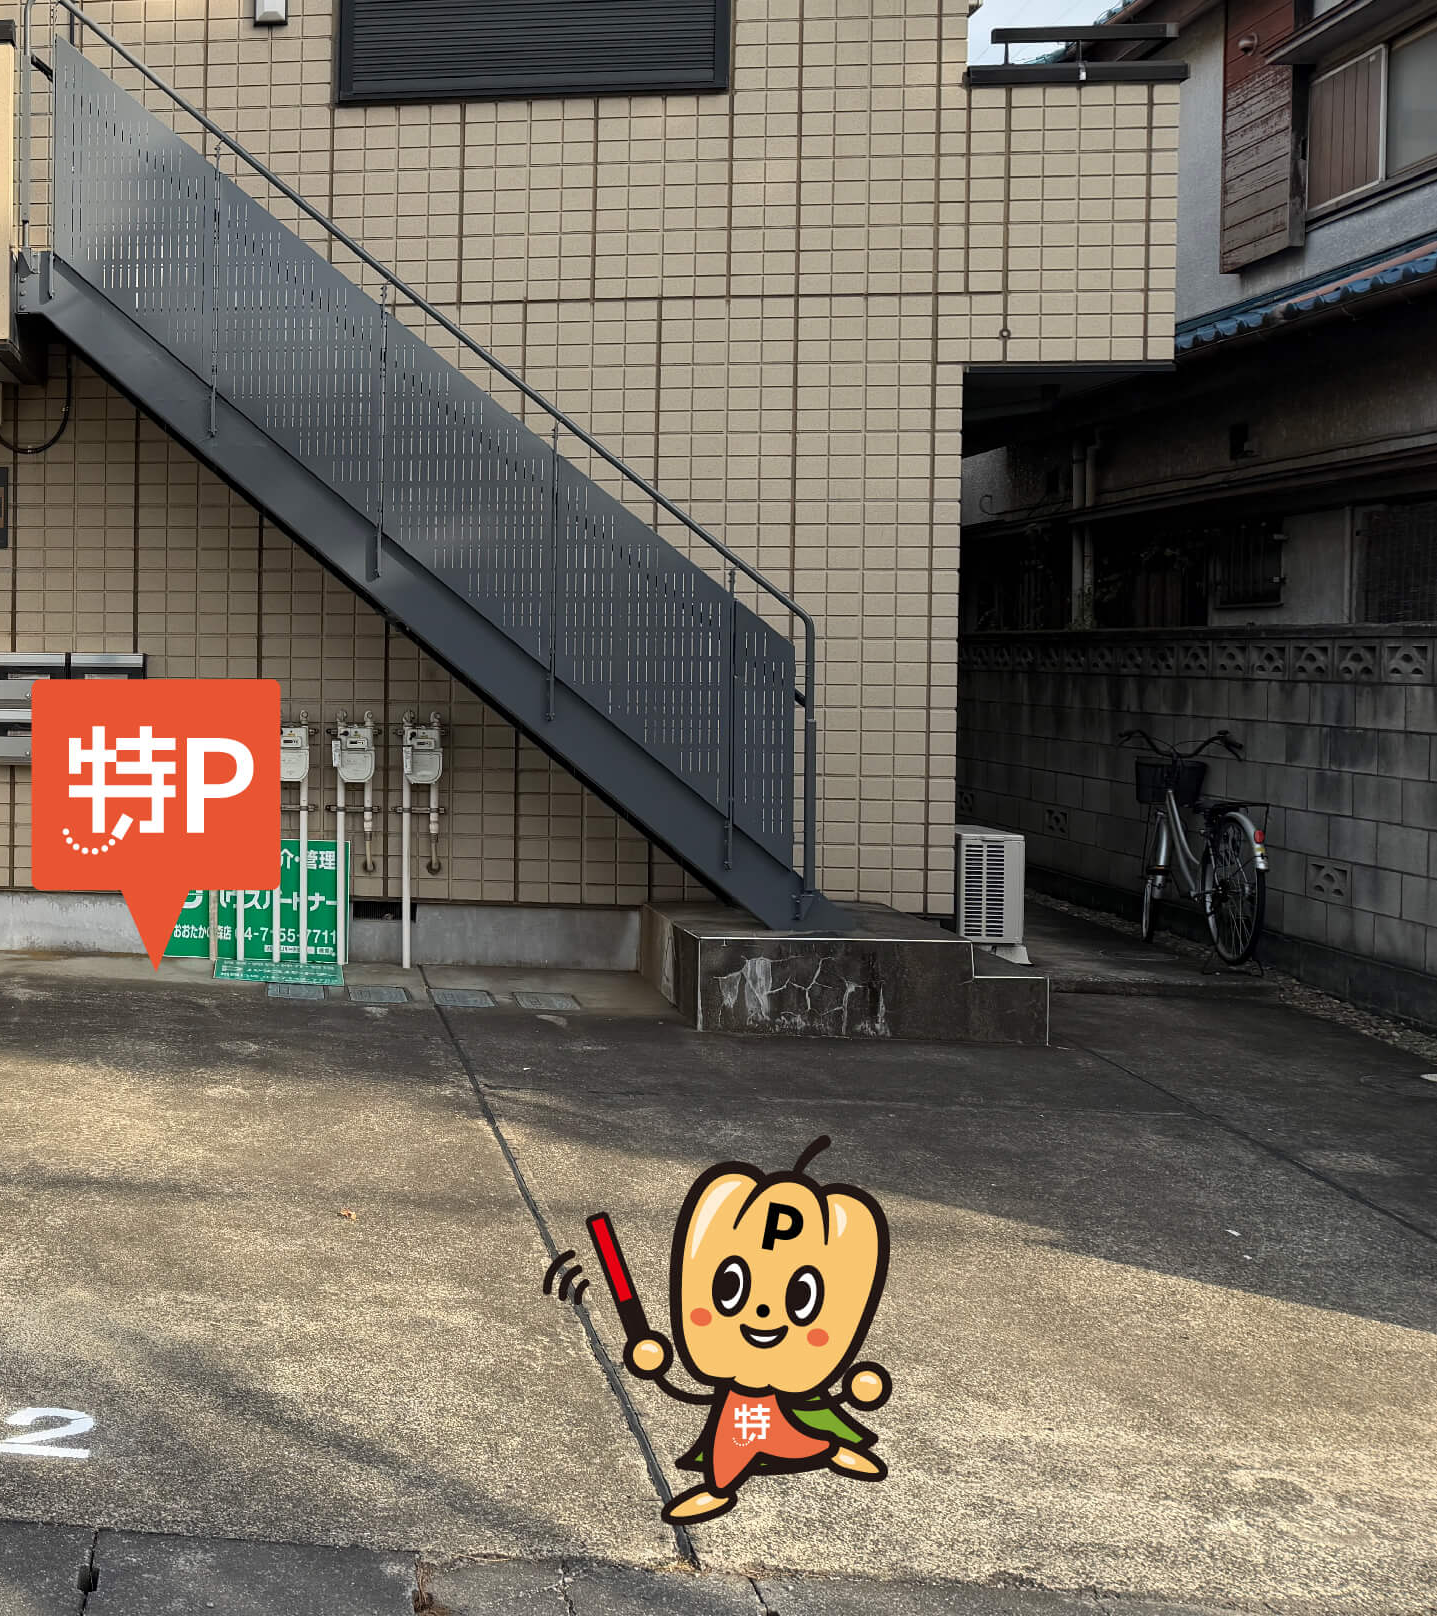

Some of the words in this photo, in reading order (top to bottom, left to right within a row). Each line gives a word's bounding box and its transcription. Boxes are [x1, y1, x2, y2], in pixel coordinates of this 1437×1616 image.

[173, 924, 232, 941] おおたか森店
[235, 926, 336, 945] 4-755-7711
